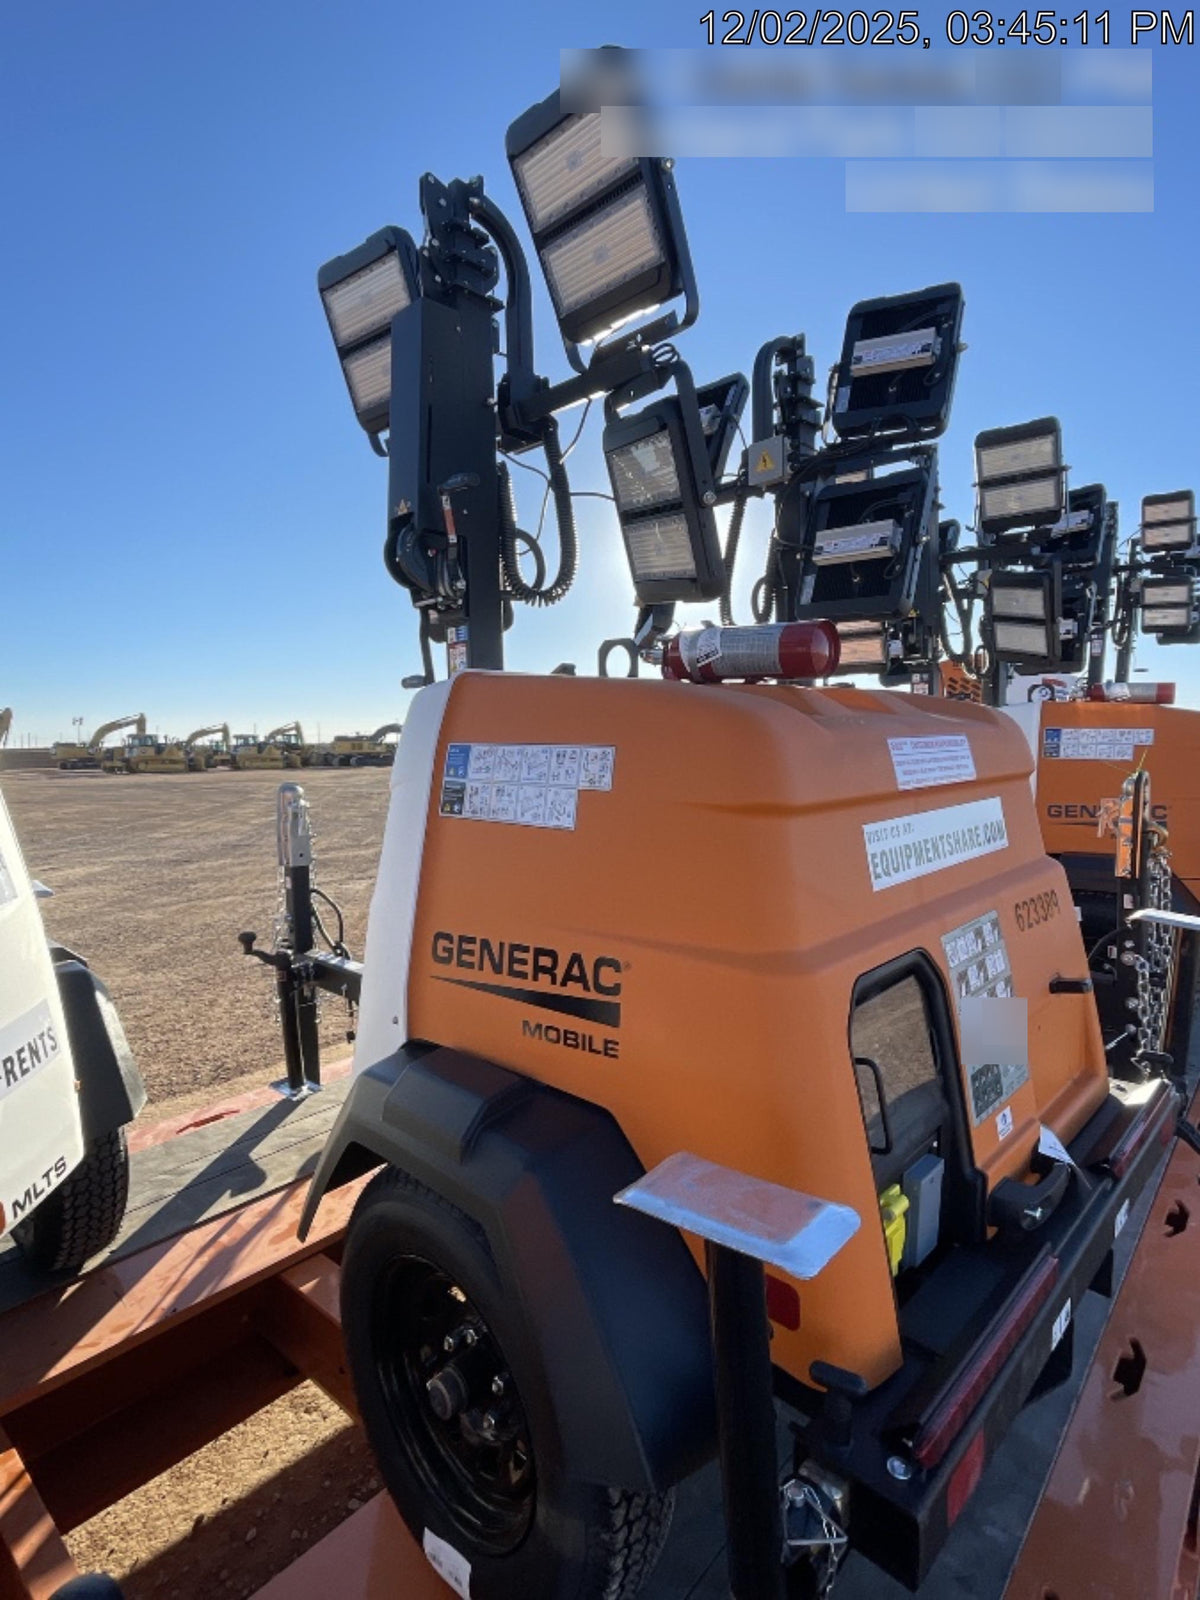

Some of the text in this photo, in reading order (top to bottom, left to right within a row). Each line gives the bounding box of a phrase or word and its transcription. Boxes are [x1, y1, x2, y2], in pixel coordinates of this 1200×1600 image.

[1047, 804, 1168, 820] GENC
[870, 819, 1006, 880] EQUIPMENTSHARE.COM
[431, 931, 622, 997] GENERAC
[521, 1019, 620, 1059] MOBILE
[11, 1155, 67, 1219] MLTS
